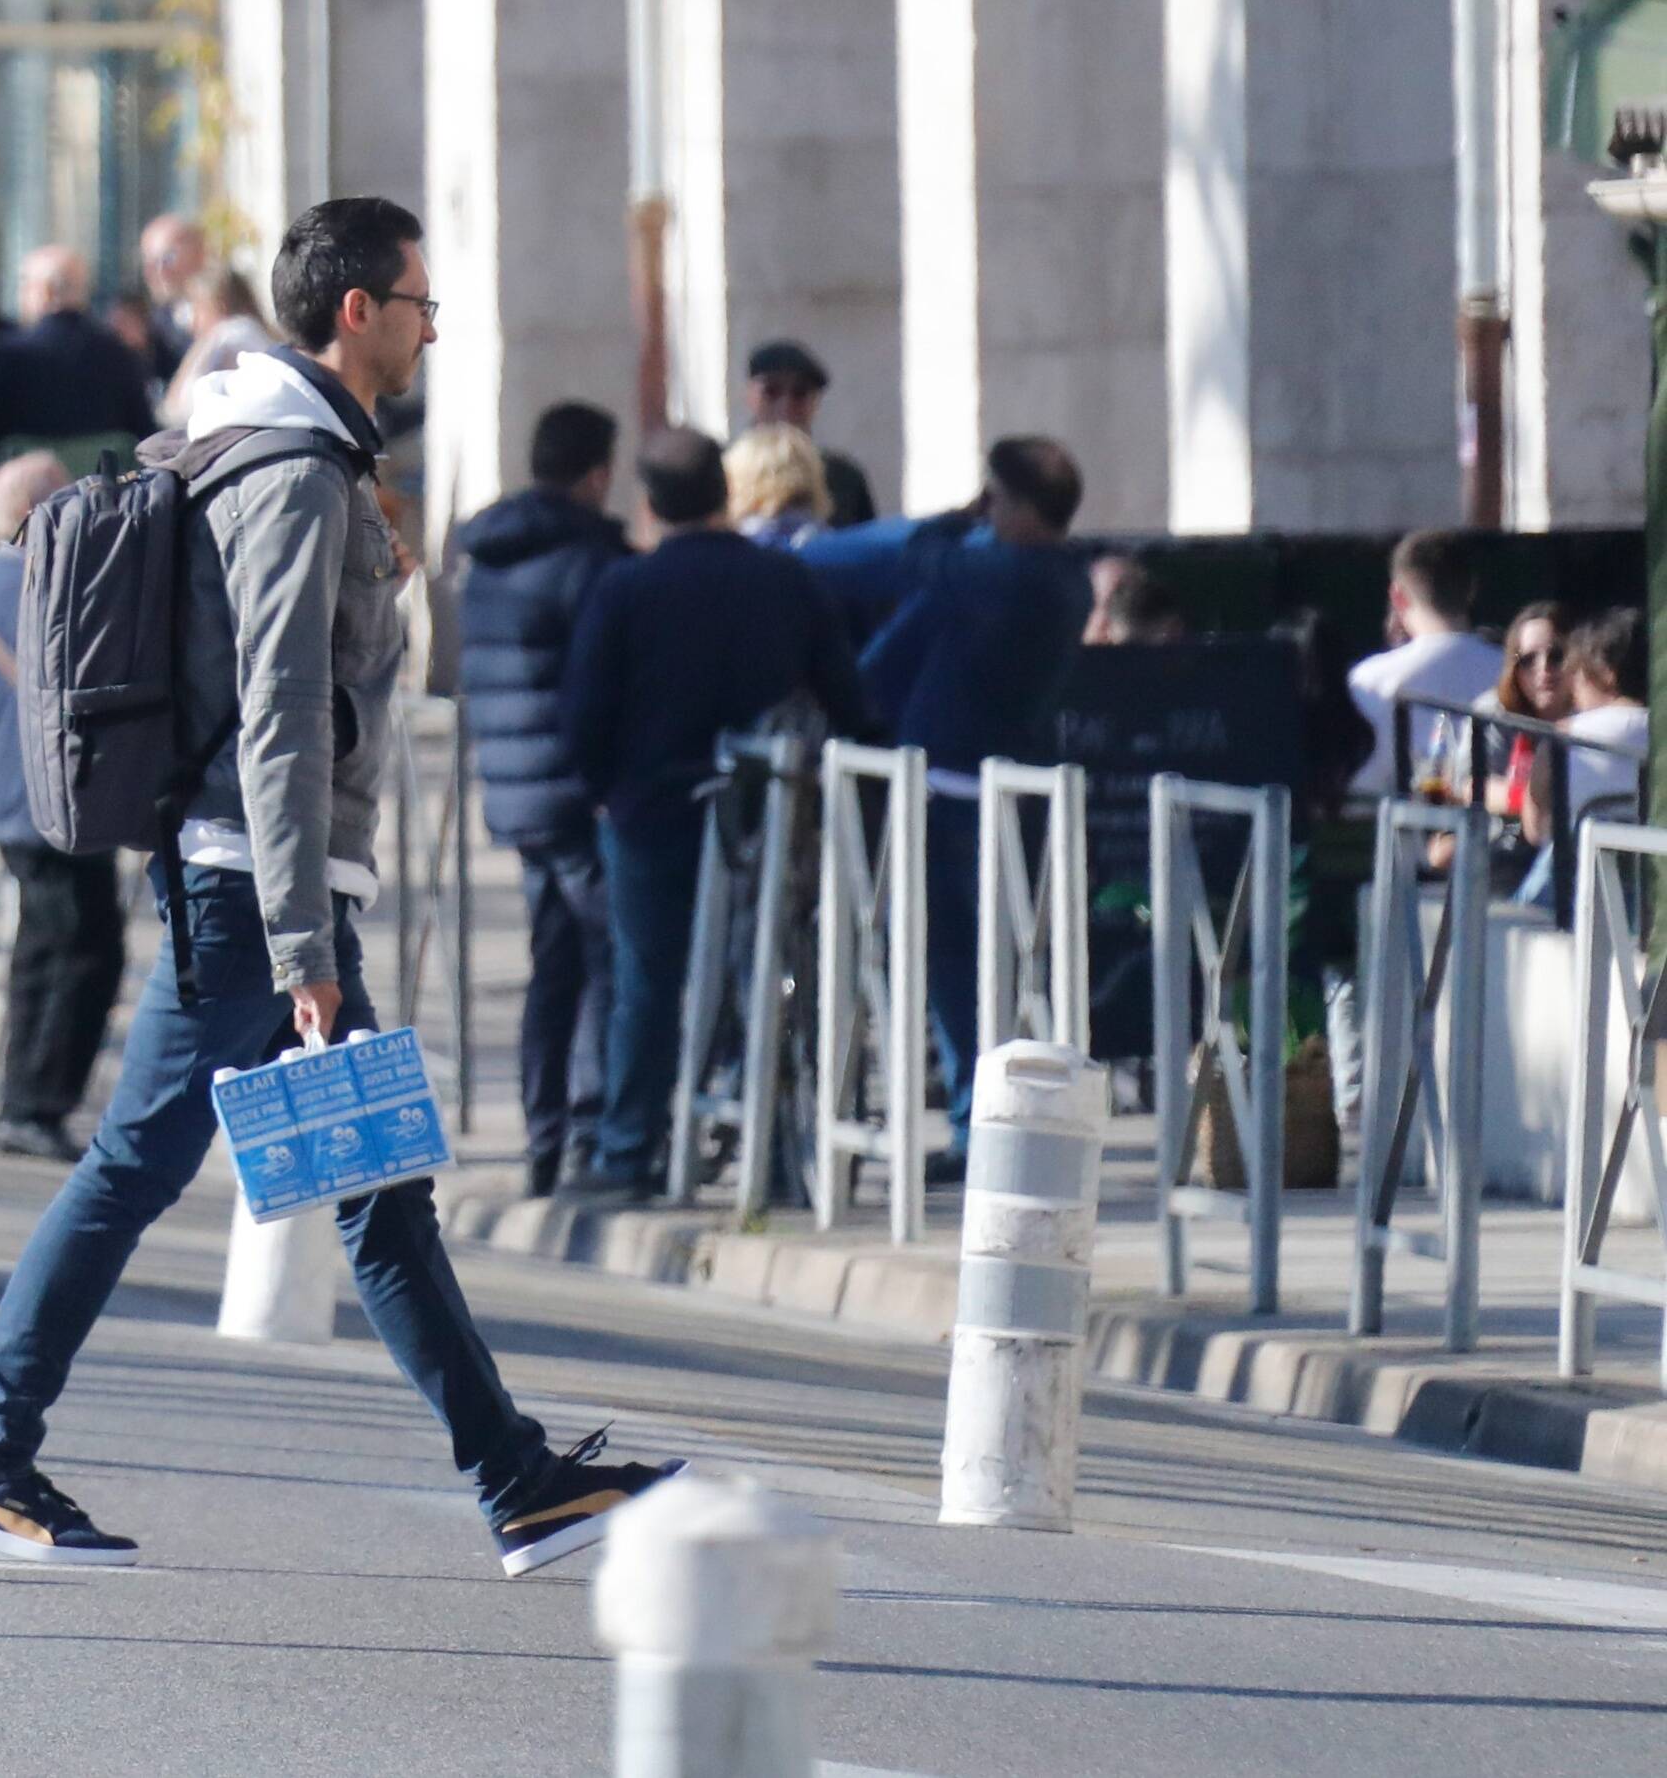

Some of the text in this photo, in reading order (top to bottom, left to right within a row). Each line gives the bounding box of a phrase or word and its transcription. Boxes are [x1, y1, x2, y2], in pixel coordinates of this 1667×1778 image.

[355, 1035, 412, 1060] CE LAIT
[286, 1063, 307, 1080] CE
[309, 1052, 344, 1074] LAIT
[219, 1083, 240, 1100] CE
[242, 1072, 276, 1095] LAIT
